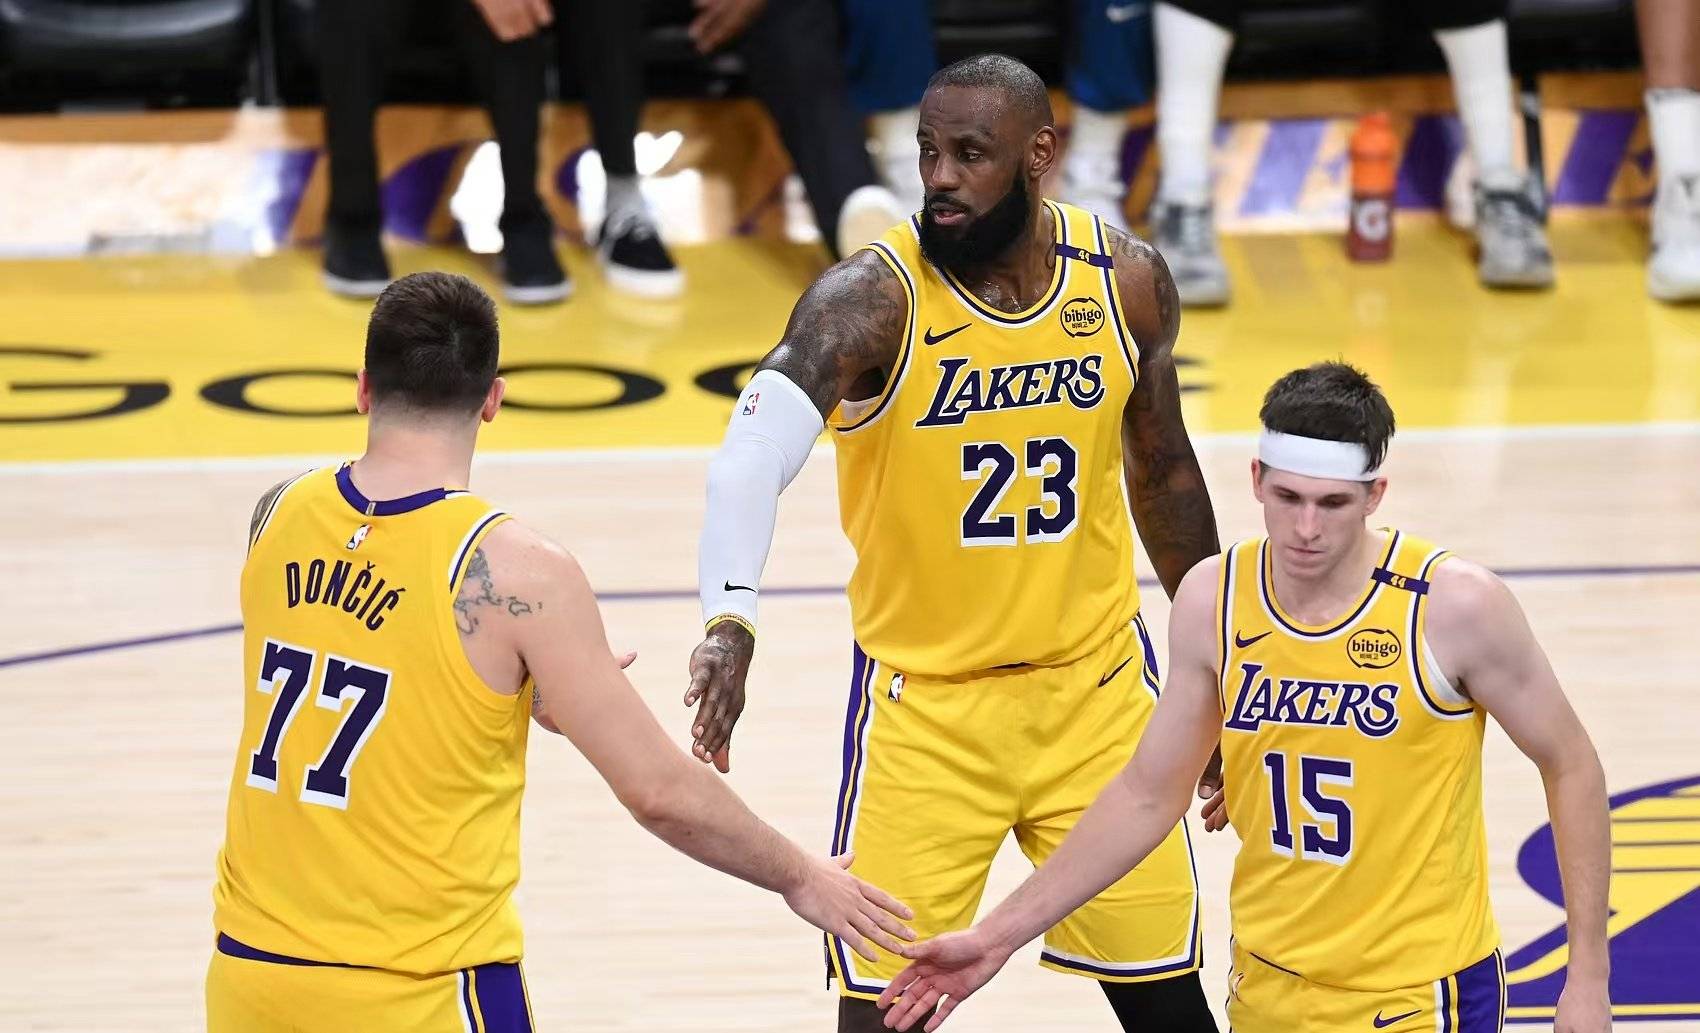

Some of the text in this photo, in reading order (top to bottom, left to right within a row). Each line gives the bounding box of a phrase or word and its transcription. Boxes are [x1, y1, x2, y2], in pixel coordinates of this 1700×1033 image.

[1357, 199, 1388, 241] G
[1064, 308, 1101, 324] bibigo
[913, 353, 1106, 430] LAKERS
[960, 434, 1079, 547] 23
[285, 558, 406, 631] DONČIĆ
[1352, 639, 1398, 657] bibigo
[246, 640, 392, 810] 77
[1224, 661, 1400, 738] LAKERS
[1263, 750, 1353, 866] 15
